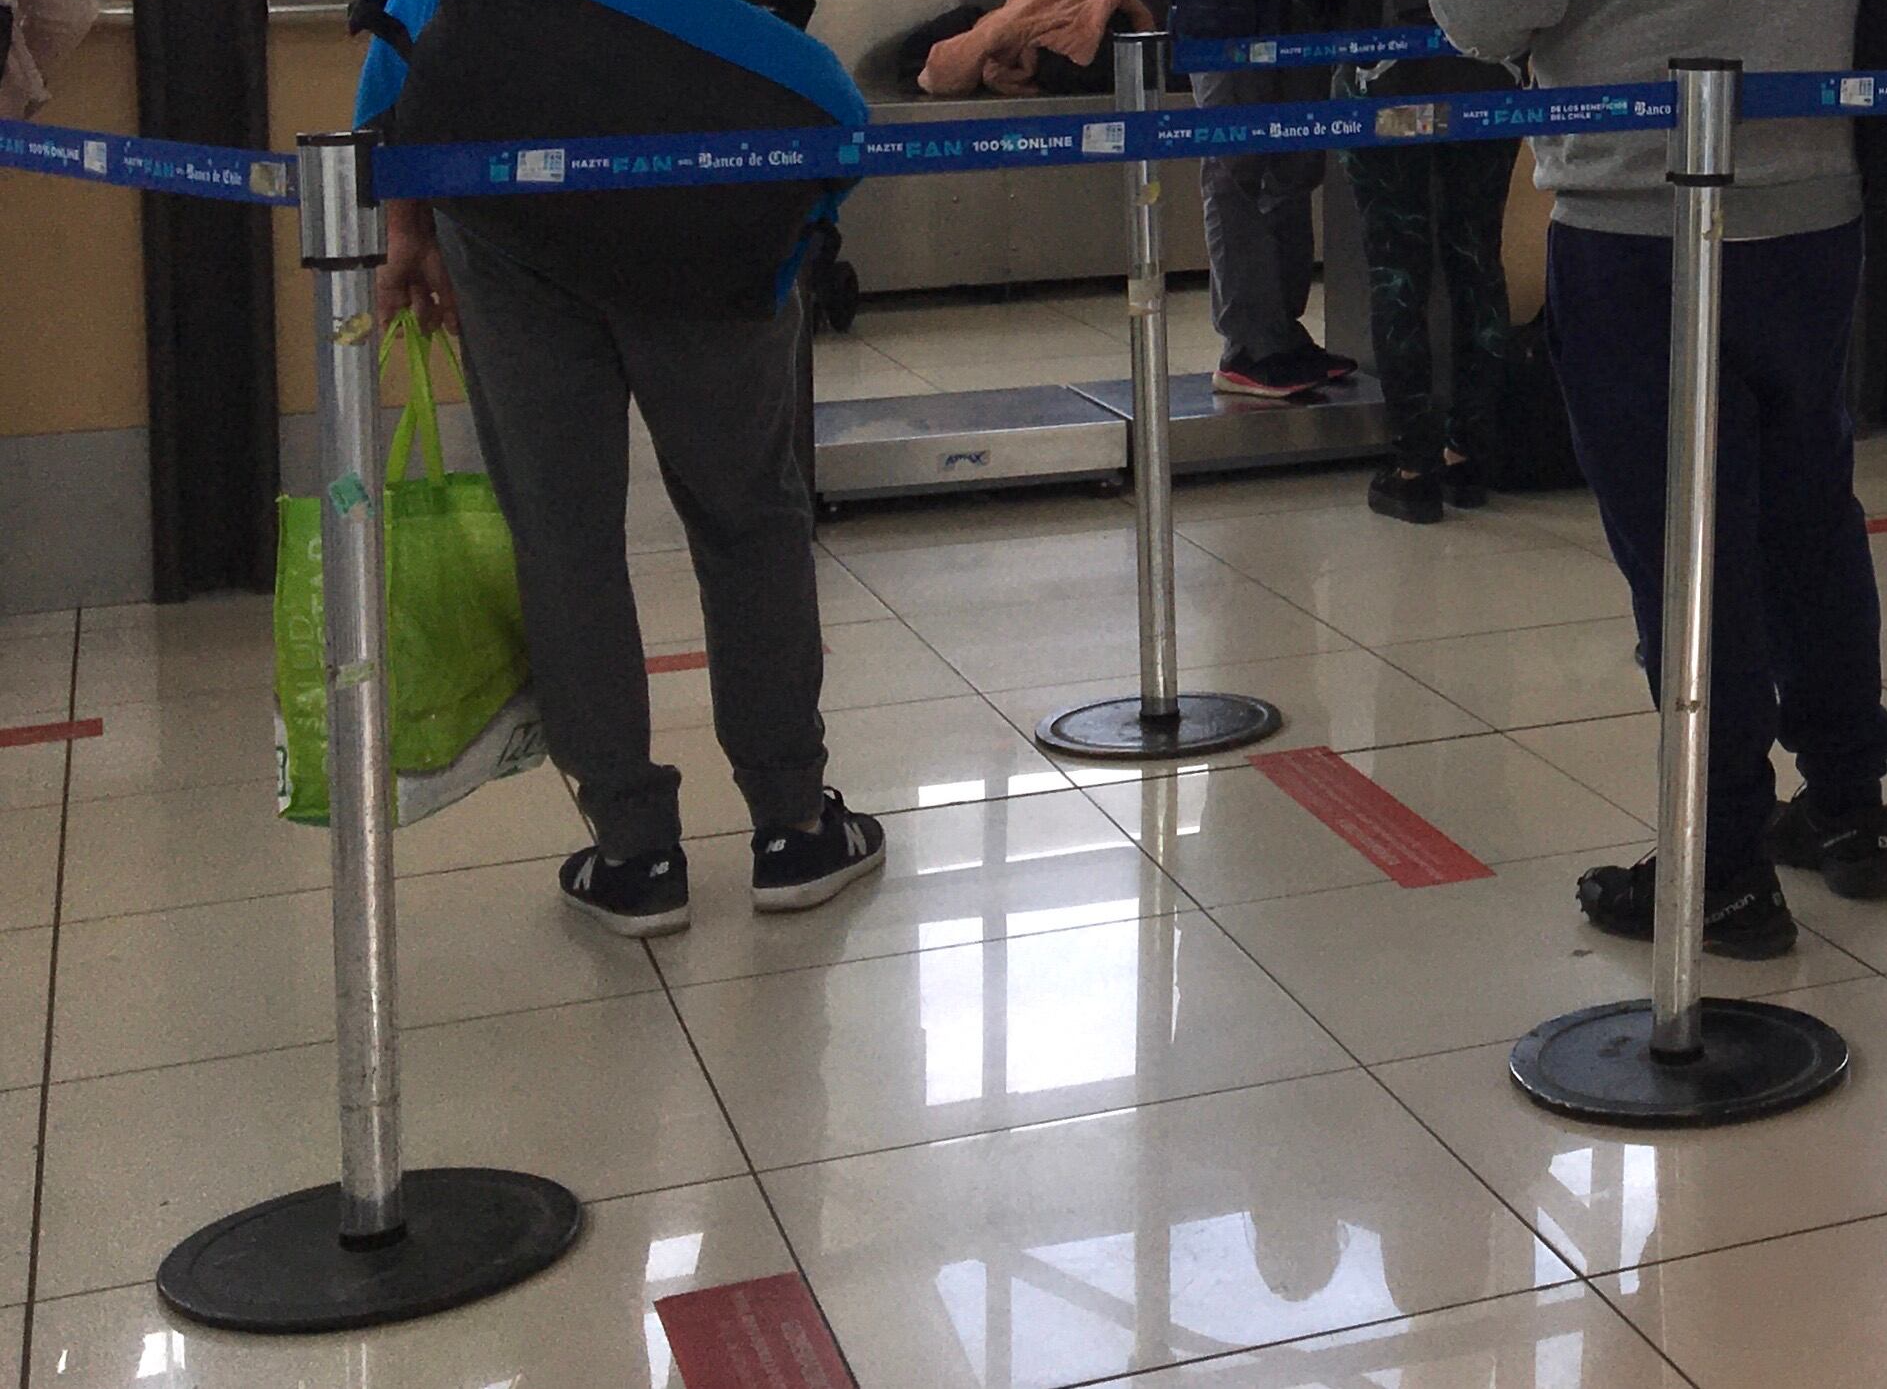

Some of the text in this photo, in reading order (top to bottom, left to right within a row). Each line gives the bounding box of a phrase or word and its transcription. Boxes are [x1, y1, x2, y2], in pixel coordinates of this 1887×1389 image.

[1303, 44, 1336, 58] FAN
[1494, 108, 1544, 124] FAN
[1634, 100, 1672, 117] Banco
[1158, 129, 1192, 139] HAZTE
[1194, 125, 1248, 143] FAN
[1269, 122, 1310, 138] Banco
[1313, 121, 1326, 136] de
[1331, 119, 1362, 135] Chile
[867, 136, 1073, 158] HAZTE FAN 100% ONLINE
[143, 158, 175, 178] FAN
[571, 158, 610, 169] HAZTE
[613, 155, 672, 174] FAN
[698, 151, 744, 170] Banco
[749, 151, 763, 167] de
[767, 149, 804, 166] Chile
